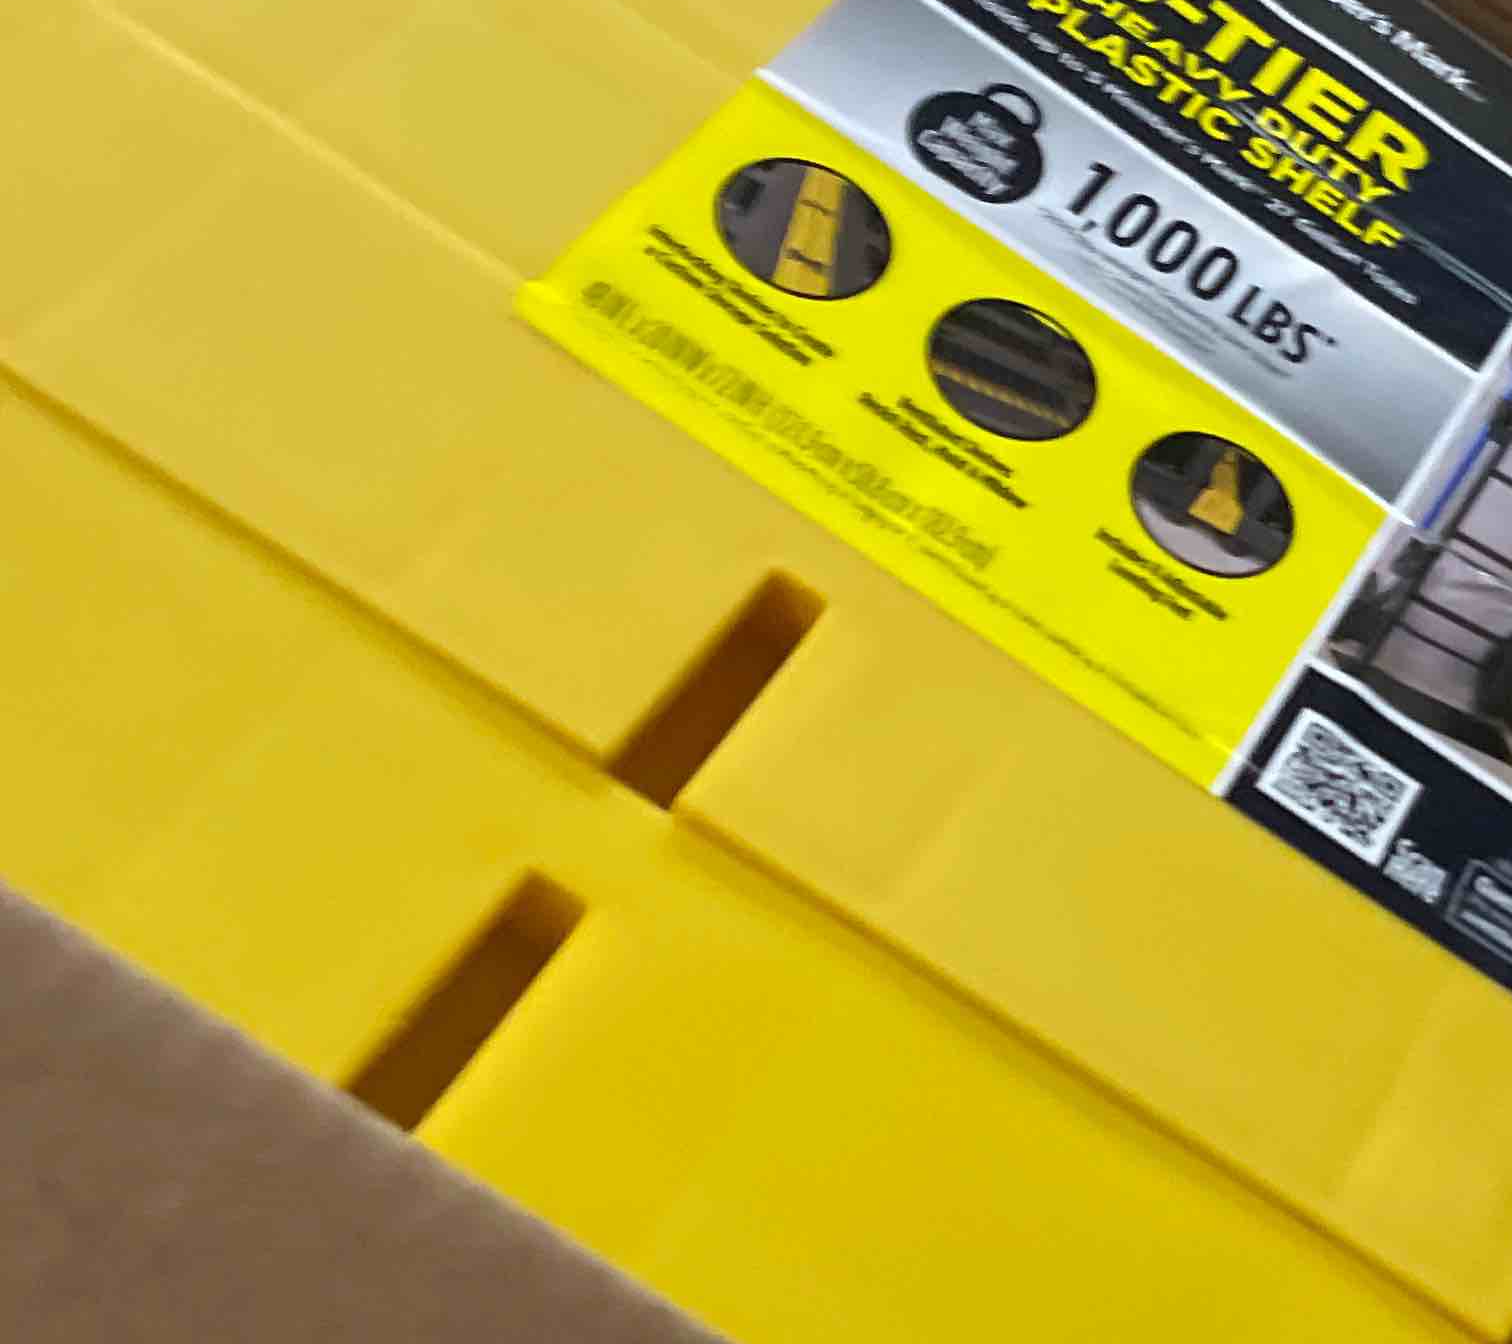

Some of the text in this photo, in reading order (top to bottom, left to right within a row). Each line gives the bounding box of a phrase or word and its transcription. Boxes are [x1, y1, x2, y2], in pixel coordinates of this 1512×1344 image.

[1241, 135, 1405, 248] SHELF
[1257, 107, 1393, 203] DUTY
[1065, 161, 1240, 302] 1,000
